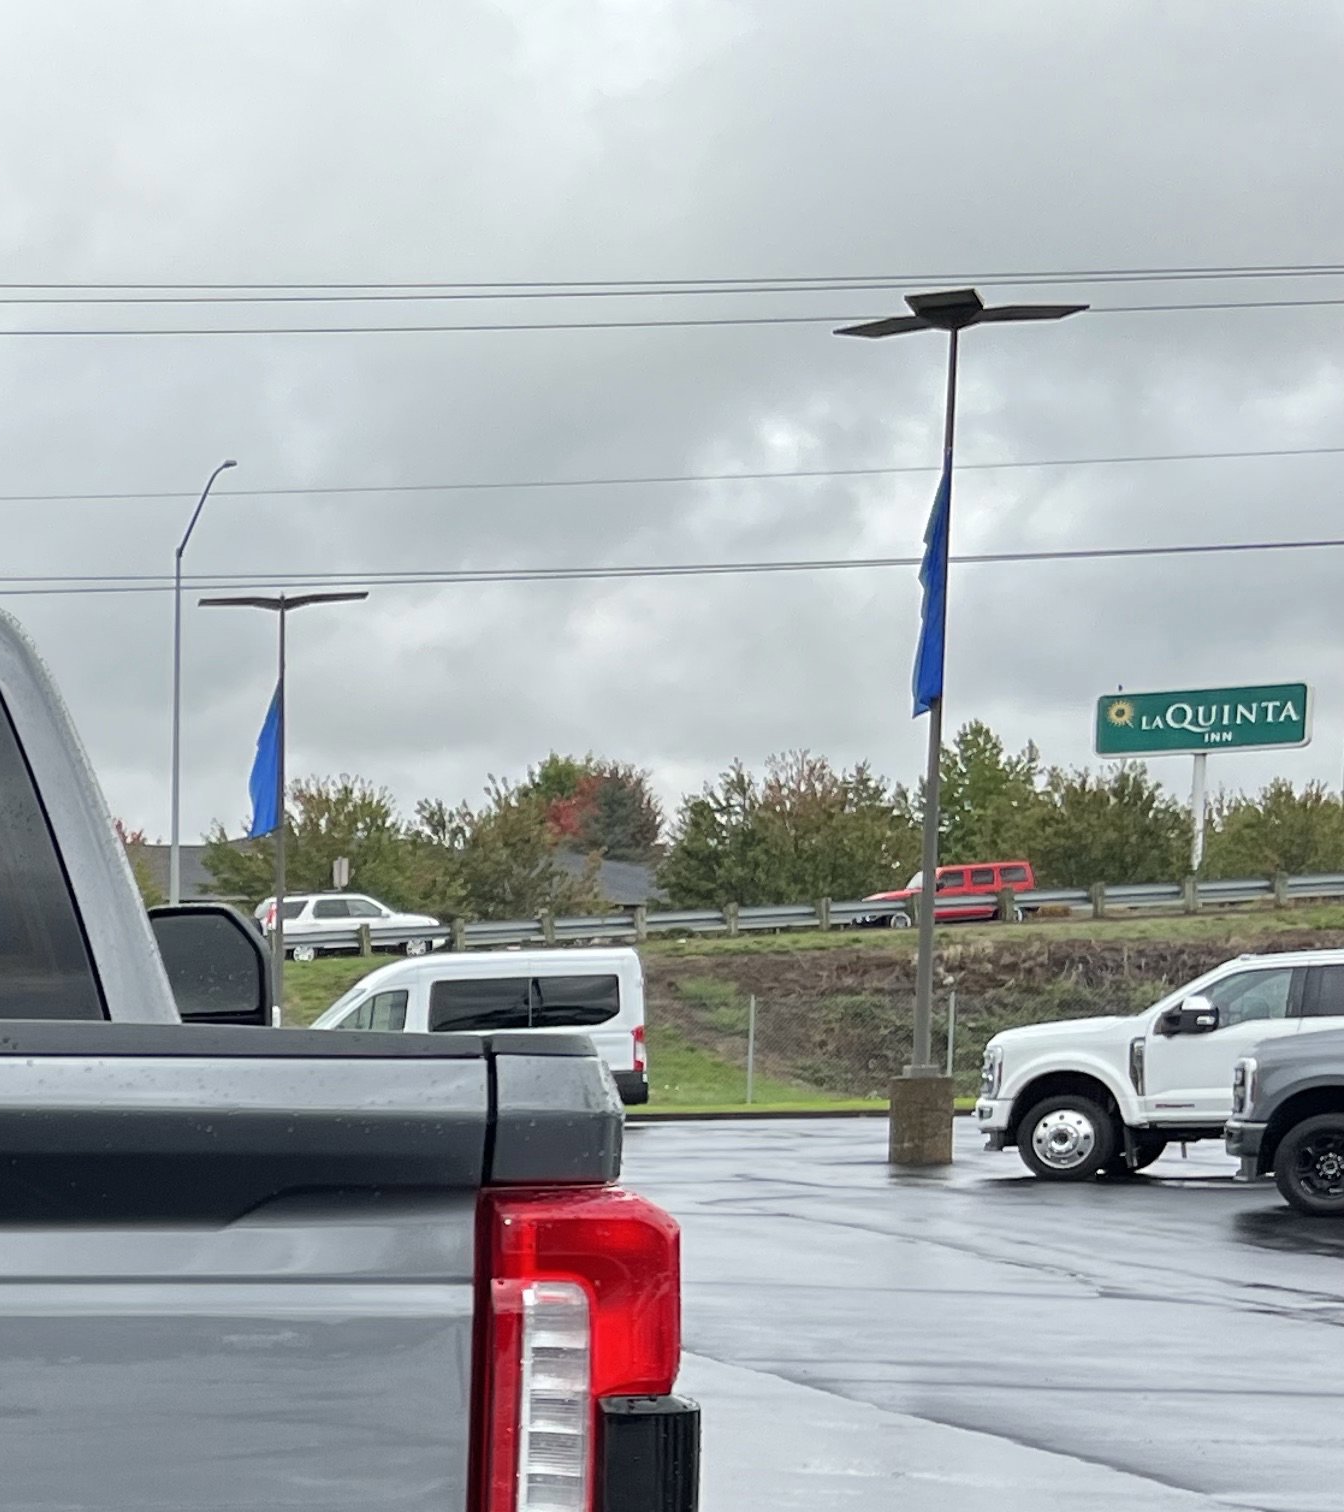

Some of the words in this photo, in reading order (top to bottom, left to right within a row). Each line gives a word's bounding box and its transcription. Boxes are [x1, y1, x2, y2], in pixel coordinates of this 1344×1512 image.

[1141, 715, 1164, 730] LA
[1165, 701, 1300, 733] QUINTA
[1204, 731, 1233, 743] INN
